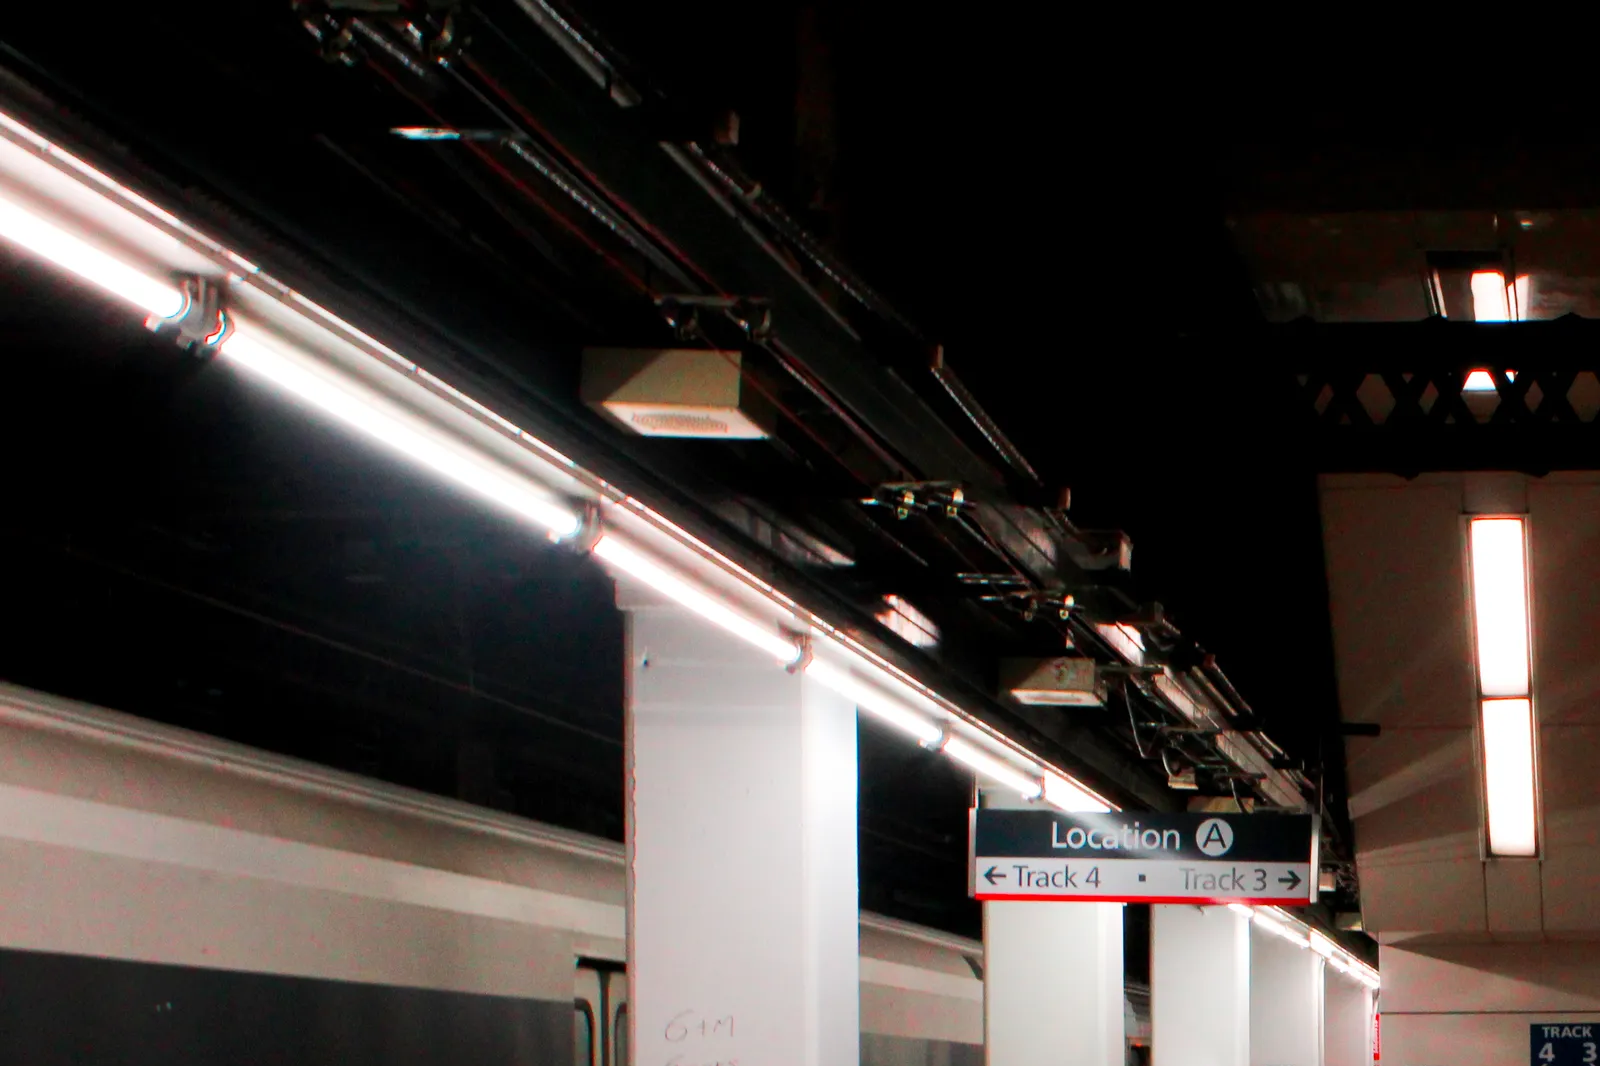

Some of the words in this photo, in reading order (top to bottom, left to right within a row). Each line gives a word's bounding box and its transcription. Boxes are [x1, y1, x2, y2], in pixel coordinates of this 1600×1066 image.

[1051, 821, 1181, 850] Location
[1201, 823, 1228, 849] A
[1012, 865, 1078, 889] Track
[1085, 866, 1102, 888] 4
[1179, 865, 1250, 891] Track
[1252, 868, 1268, 891] 3
[1541, 1026, 1593, 1038] TRACK
[1538, 1042, 1556, 1062] 4
[1582, 1041, 1598, 1063] 3
